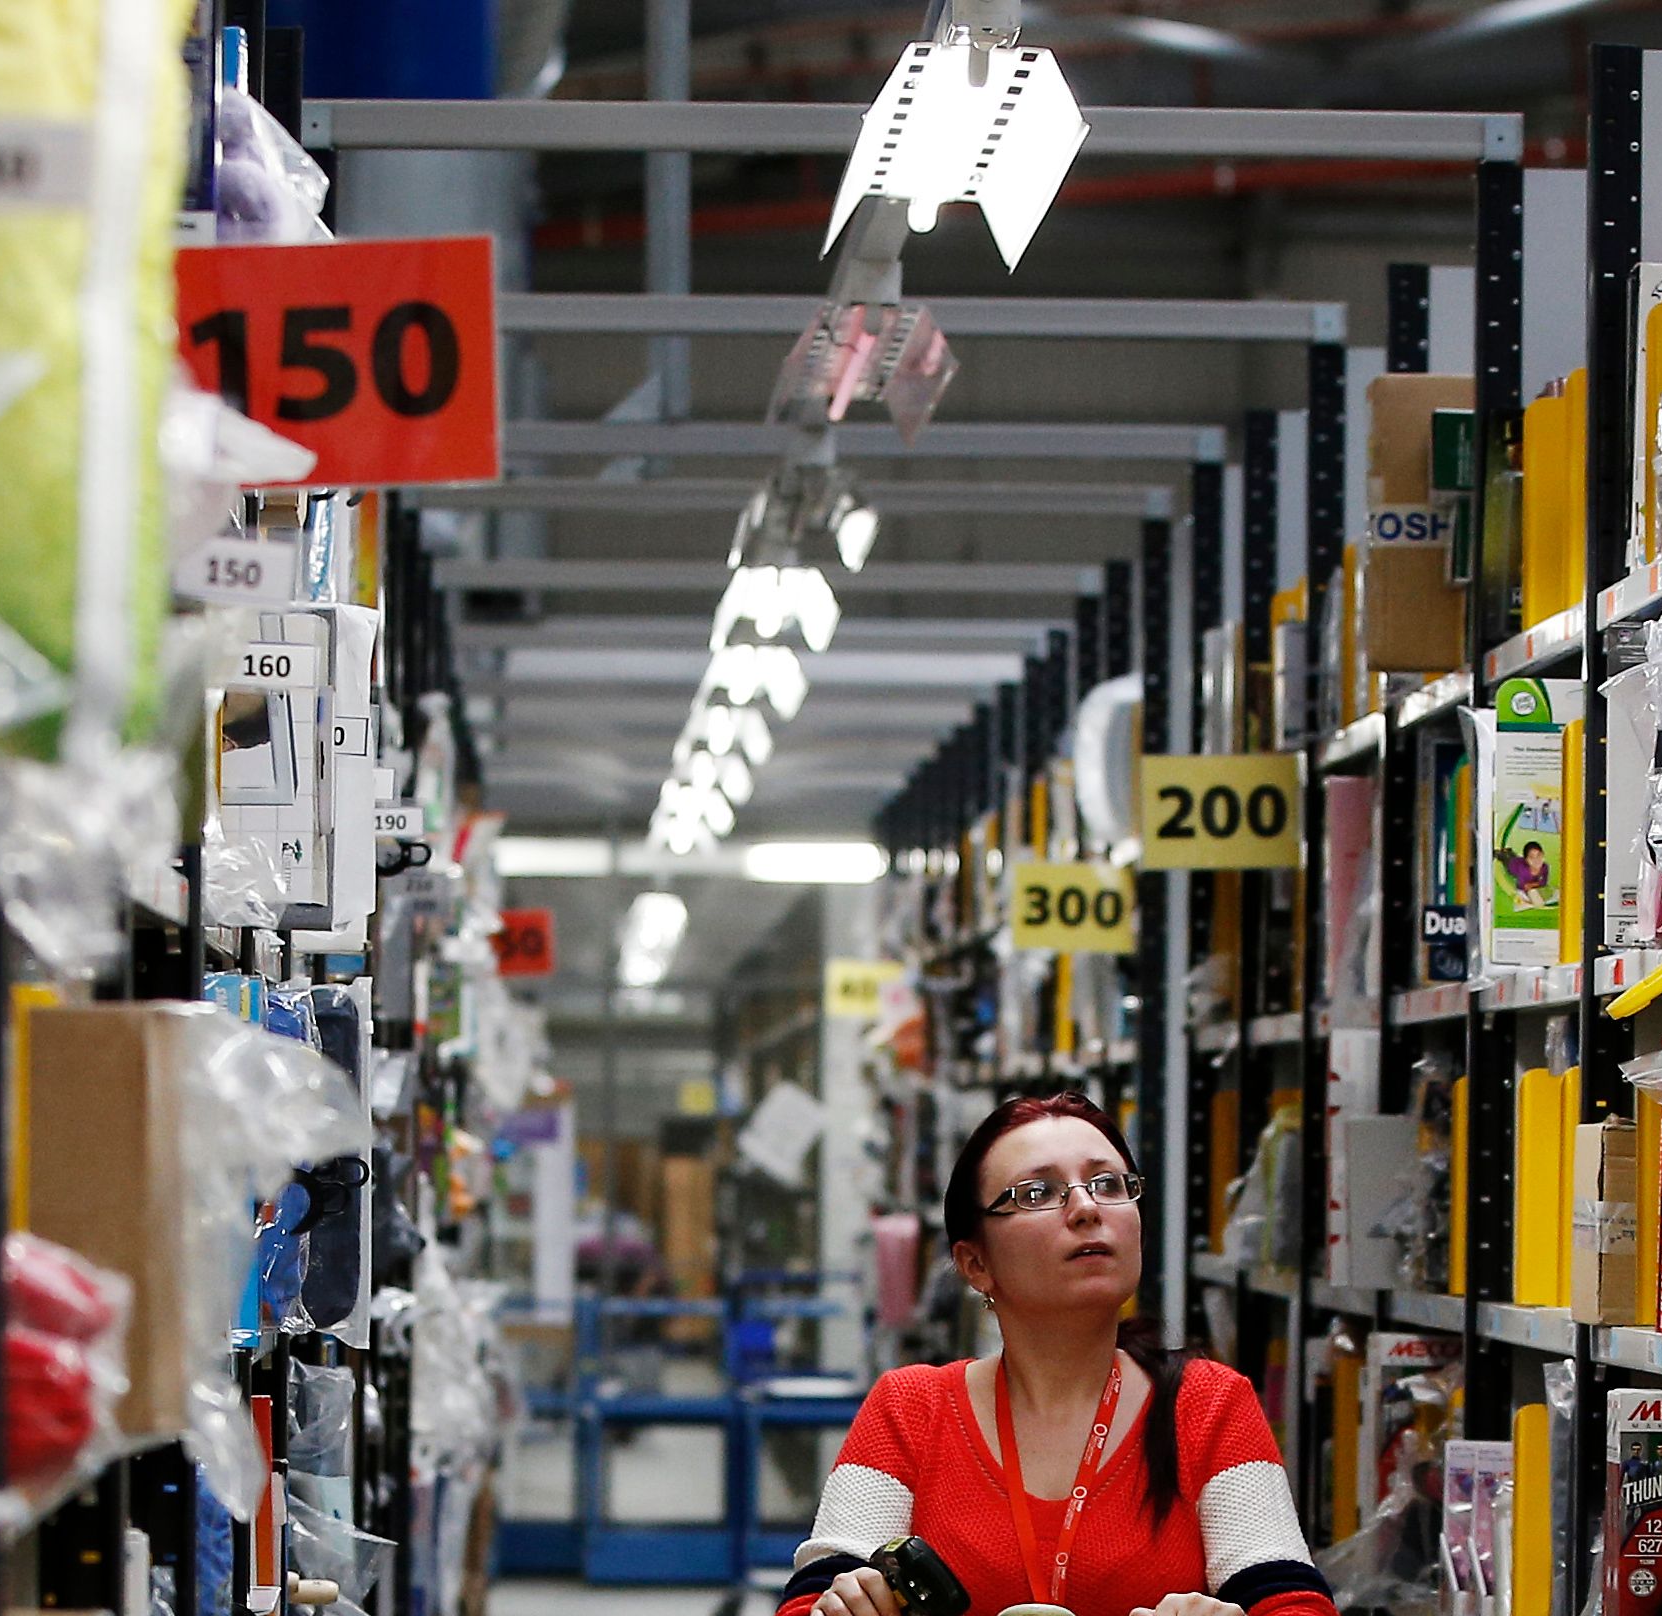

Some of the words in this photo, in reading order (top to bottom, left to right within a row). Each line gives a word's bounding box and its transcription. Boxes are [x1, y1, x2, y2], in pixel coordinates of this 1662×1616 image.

[192, 302, 459, 421] 150
[207, 561, 261, 586] 150
[243, 655, 291, 677] 160
[375, 816, 406, 830] 190
[1157, 785, 1287, 838] 200
[1024, 886, 1123, 927] 300
[1638, 1538, 1662, 1553] 627
